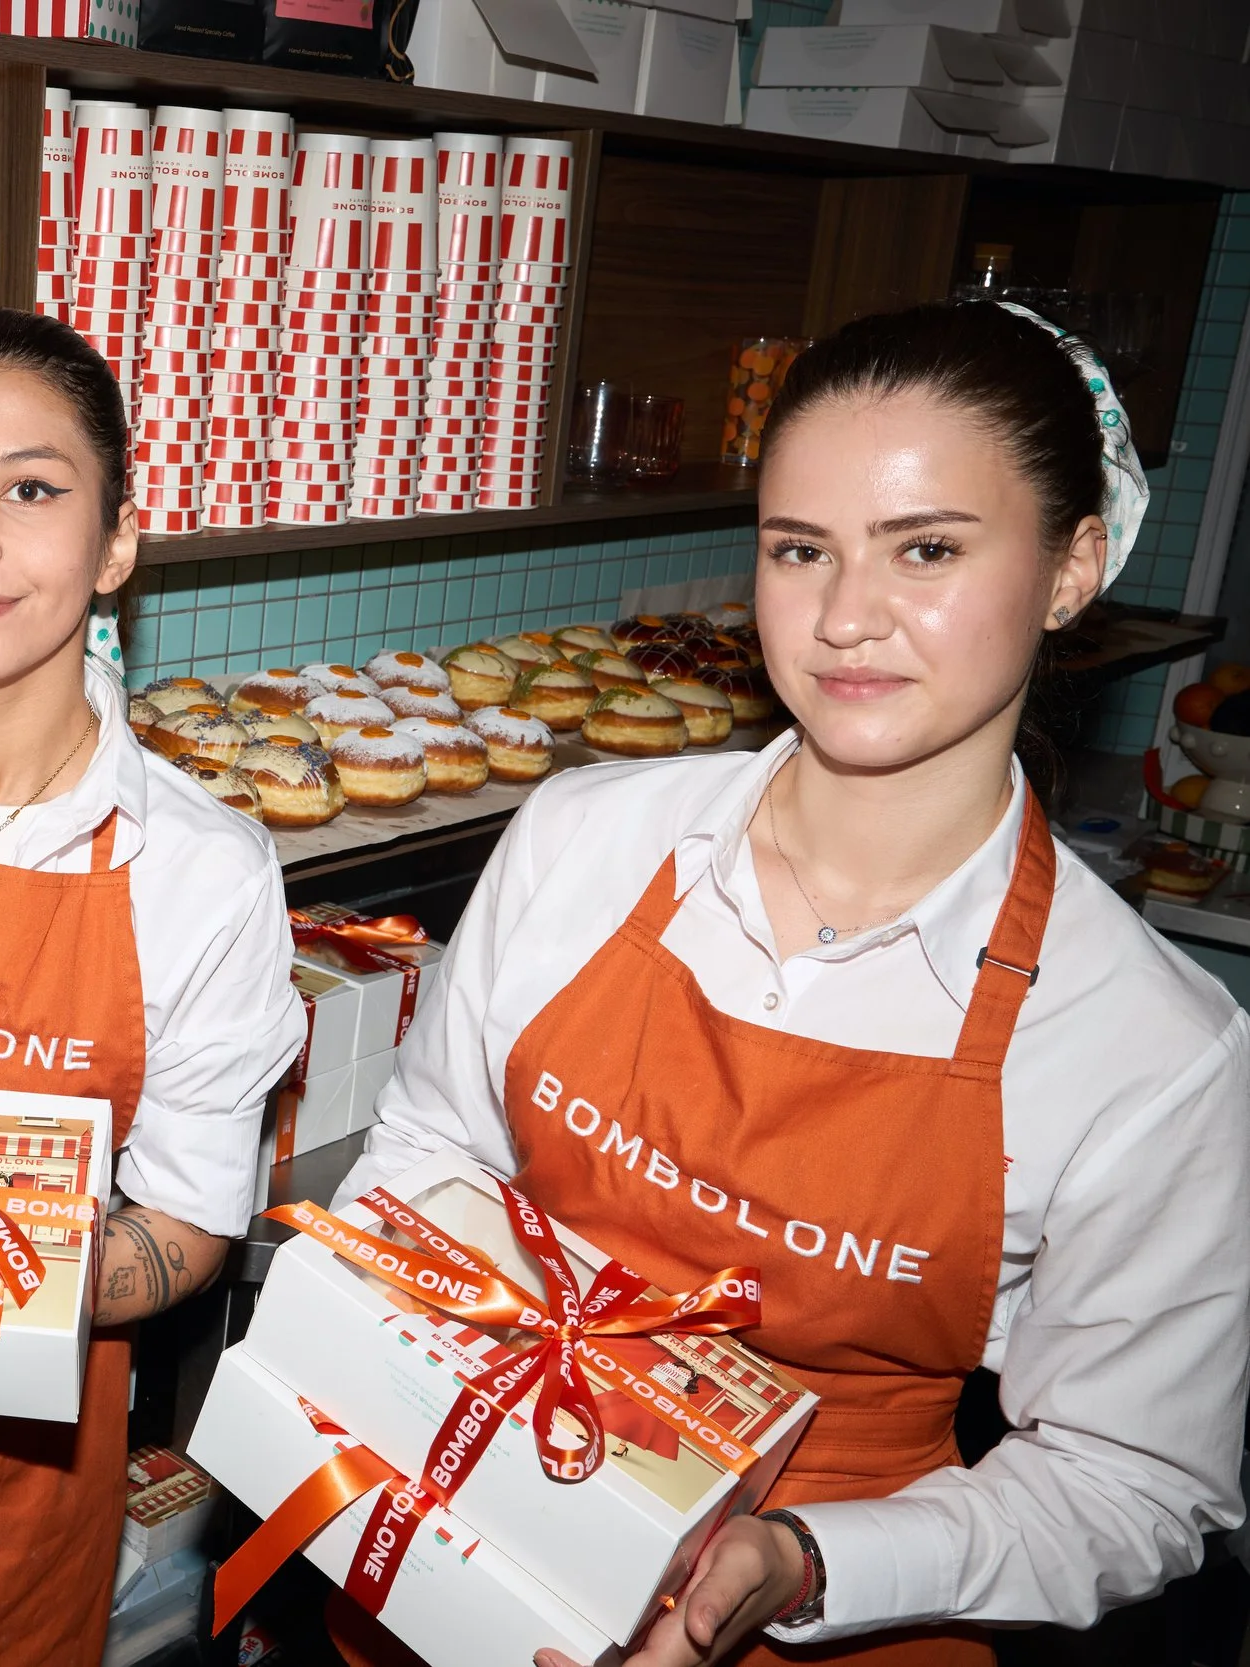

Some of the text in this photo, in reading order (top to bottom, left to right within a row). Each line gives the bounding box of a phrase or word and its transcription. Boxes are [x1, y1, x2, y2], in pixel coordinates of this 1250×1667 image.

[530, 1071, 930, 1285] BOMBOLONE
[291, 1207, 483, 1306] BOMBOLONE
[430, 1355, 539, 1489] BOMBOLONE
